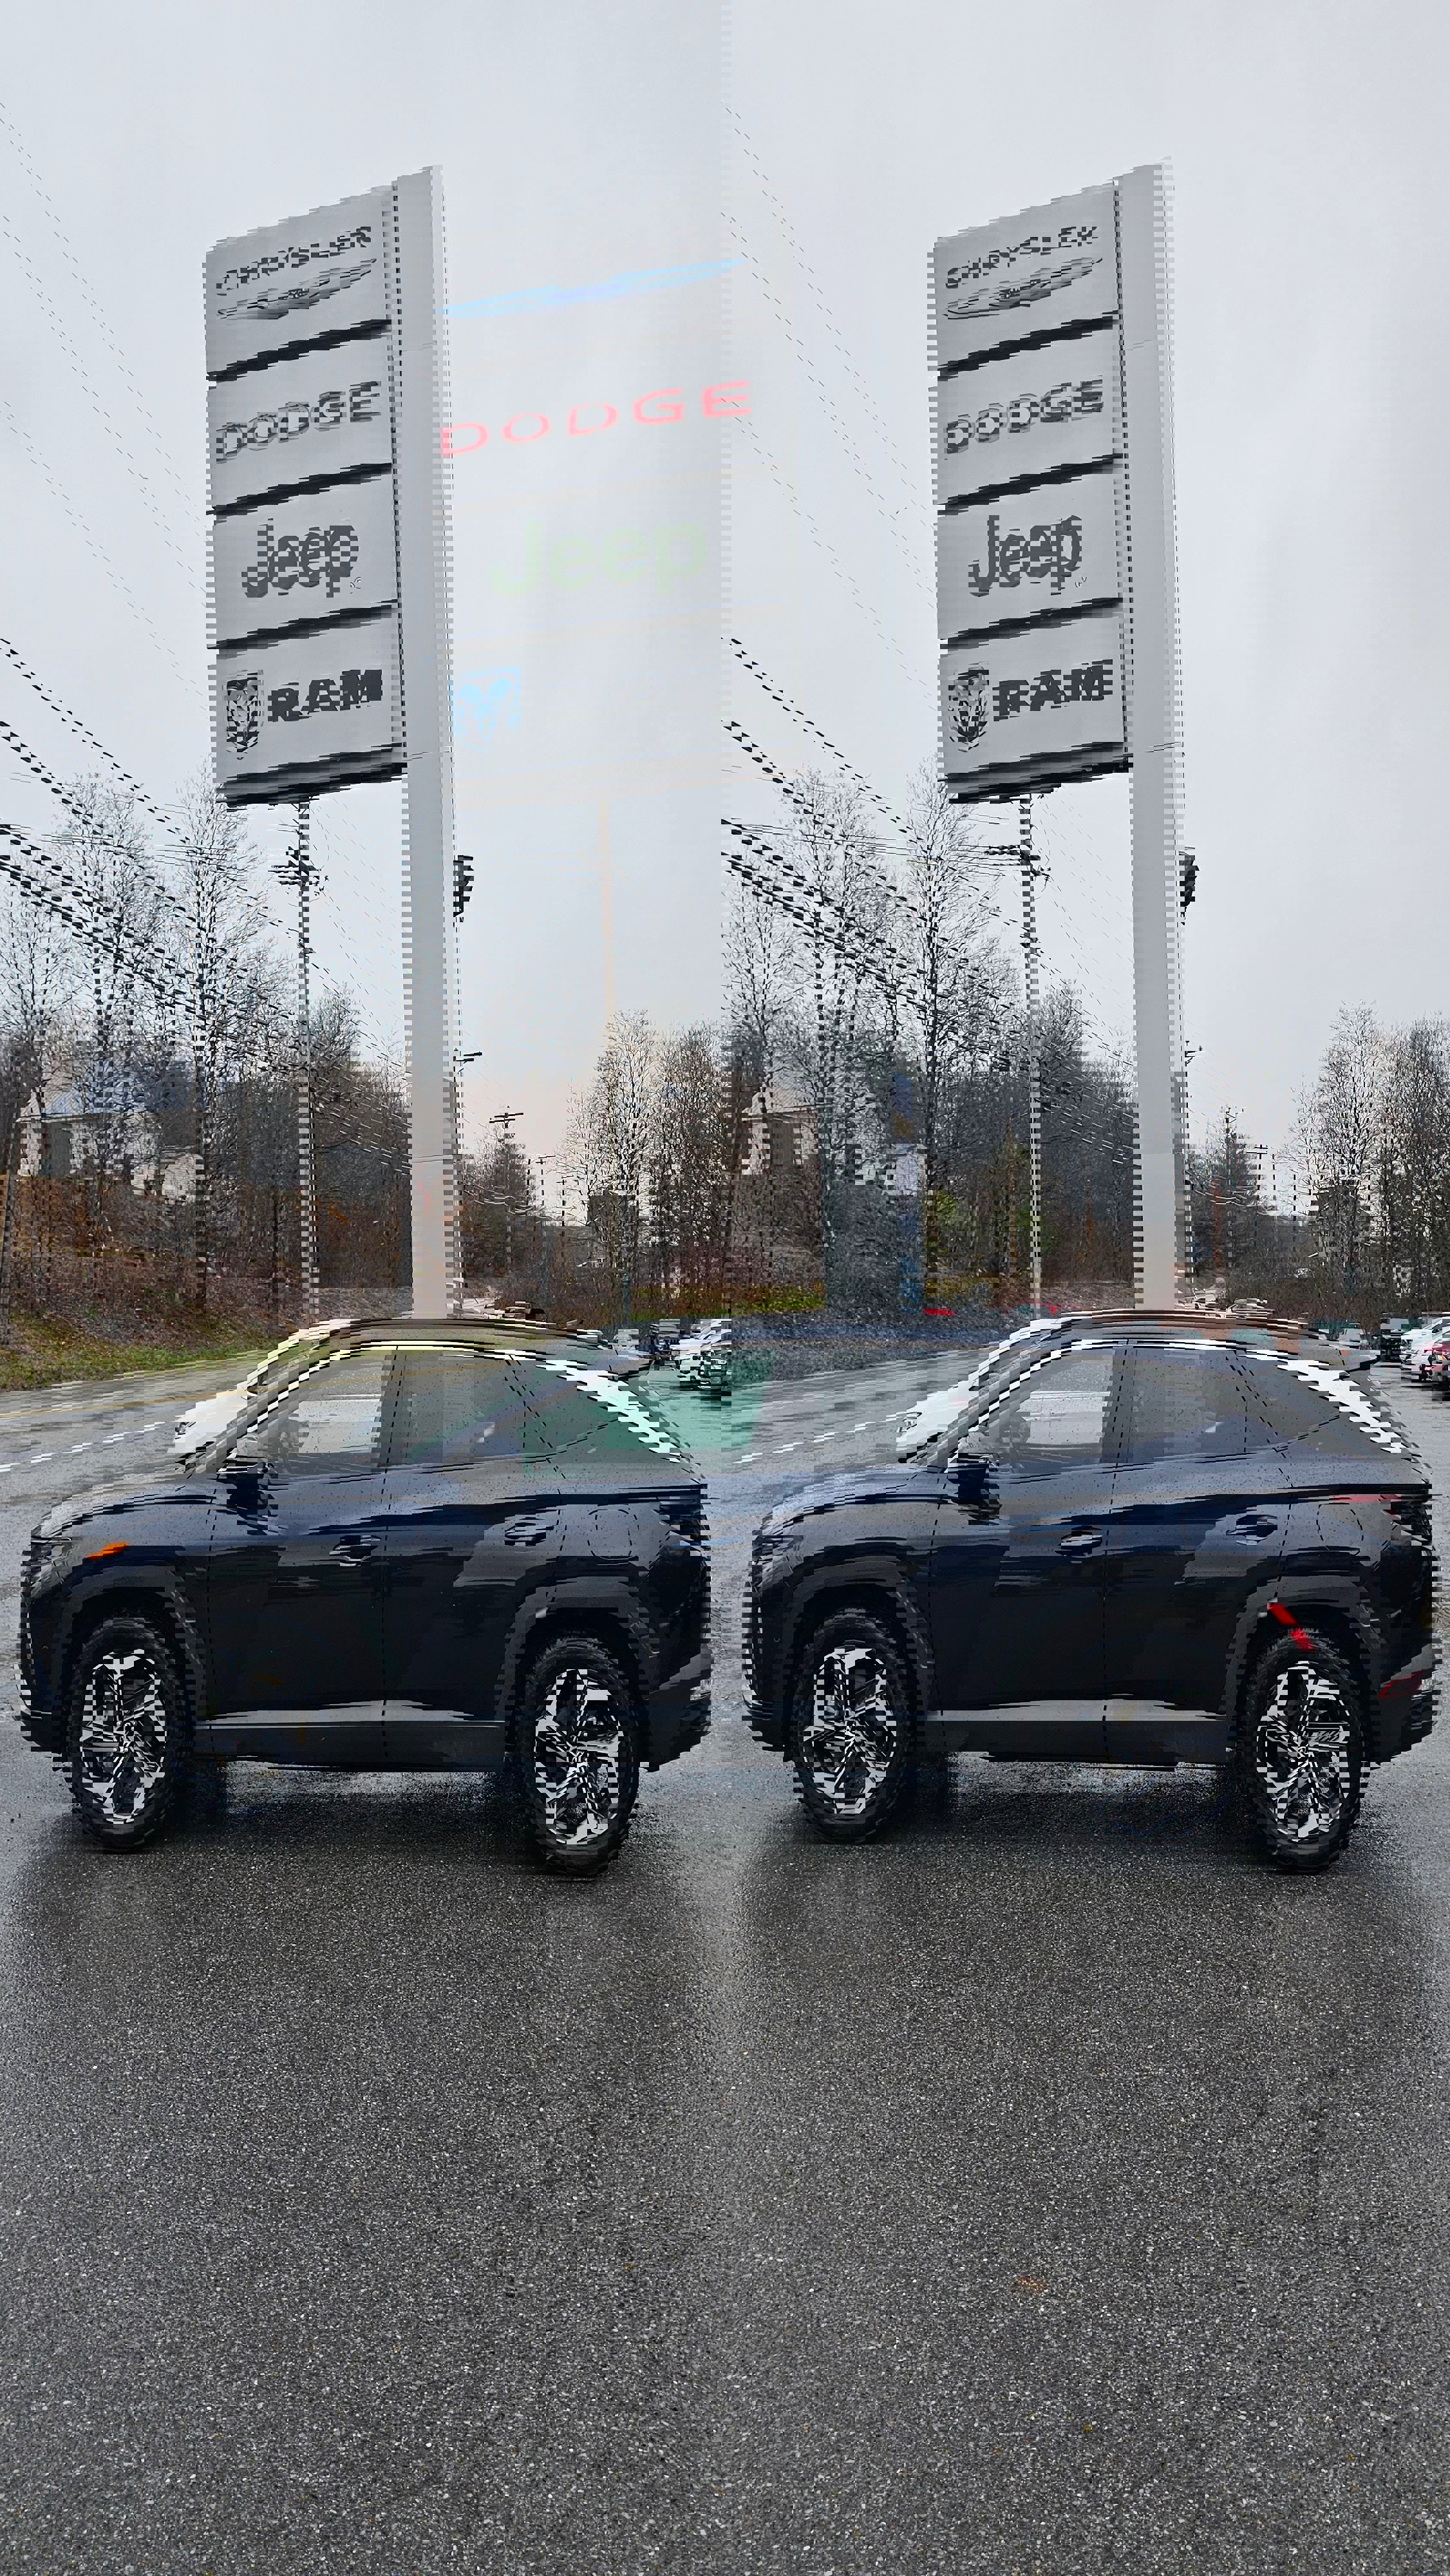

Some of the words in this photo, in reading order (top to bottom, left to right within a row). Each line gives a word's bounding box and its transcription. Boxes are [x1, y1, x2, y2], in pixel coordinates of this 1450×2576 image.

[216, 381, 381, 464] DODGE
[441, 380, 752, 459] DODGE
[944, 375, 1103, 456] DODGE
[488, 519, 708, 598] Jeep
[968, 515, 1082, 596] Jeep
[268, 668, 382, 722] RAM
[992, 659, 1113, 722] RAM
